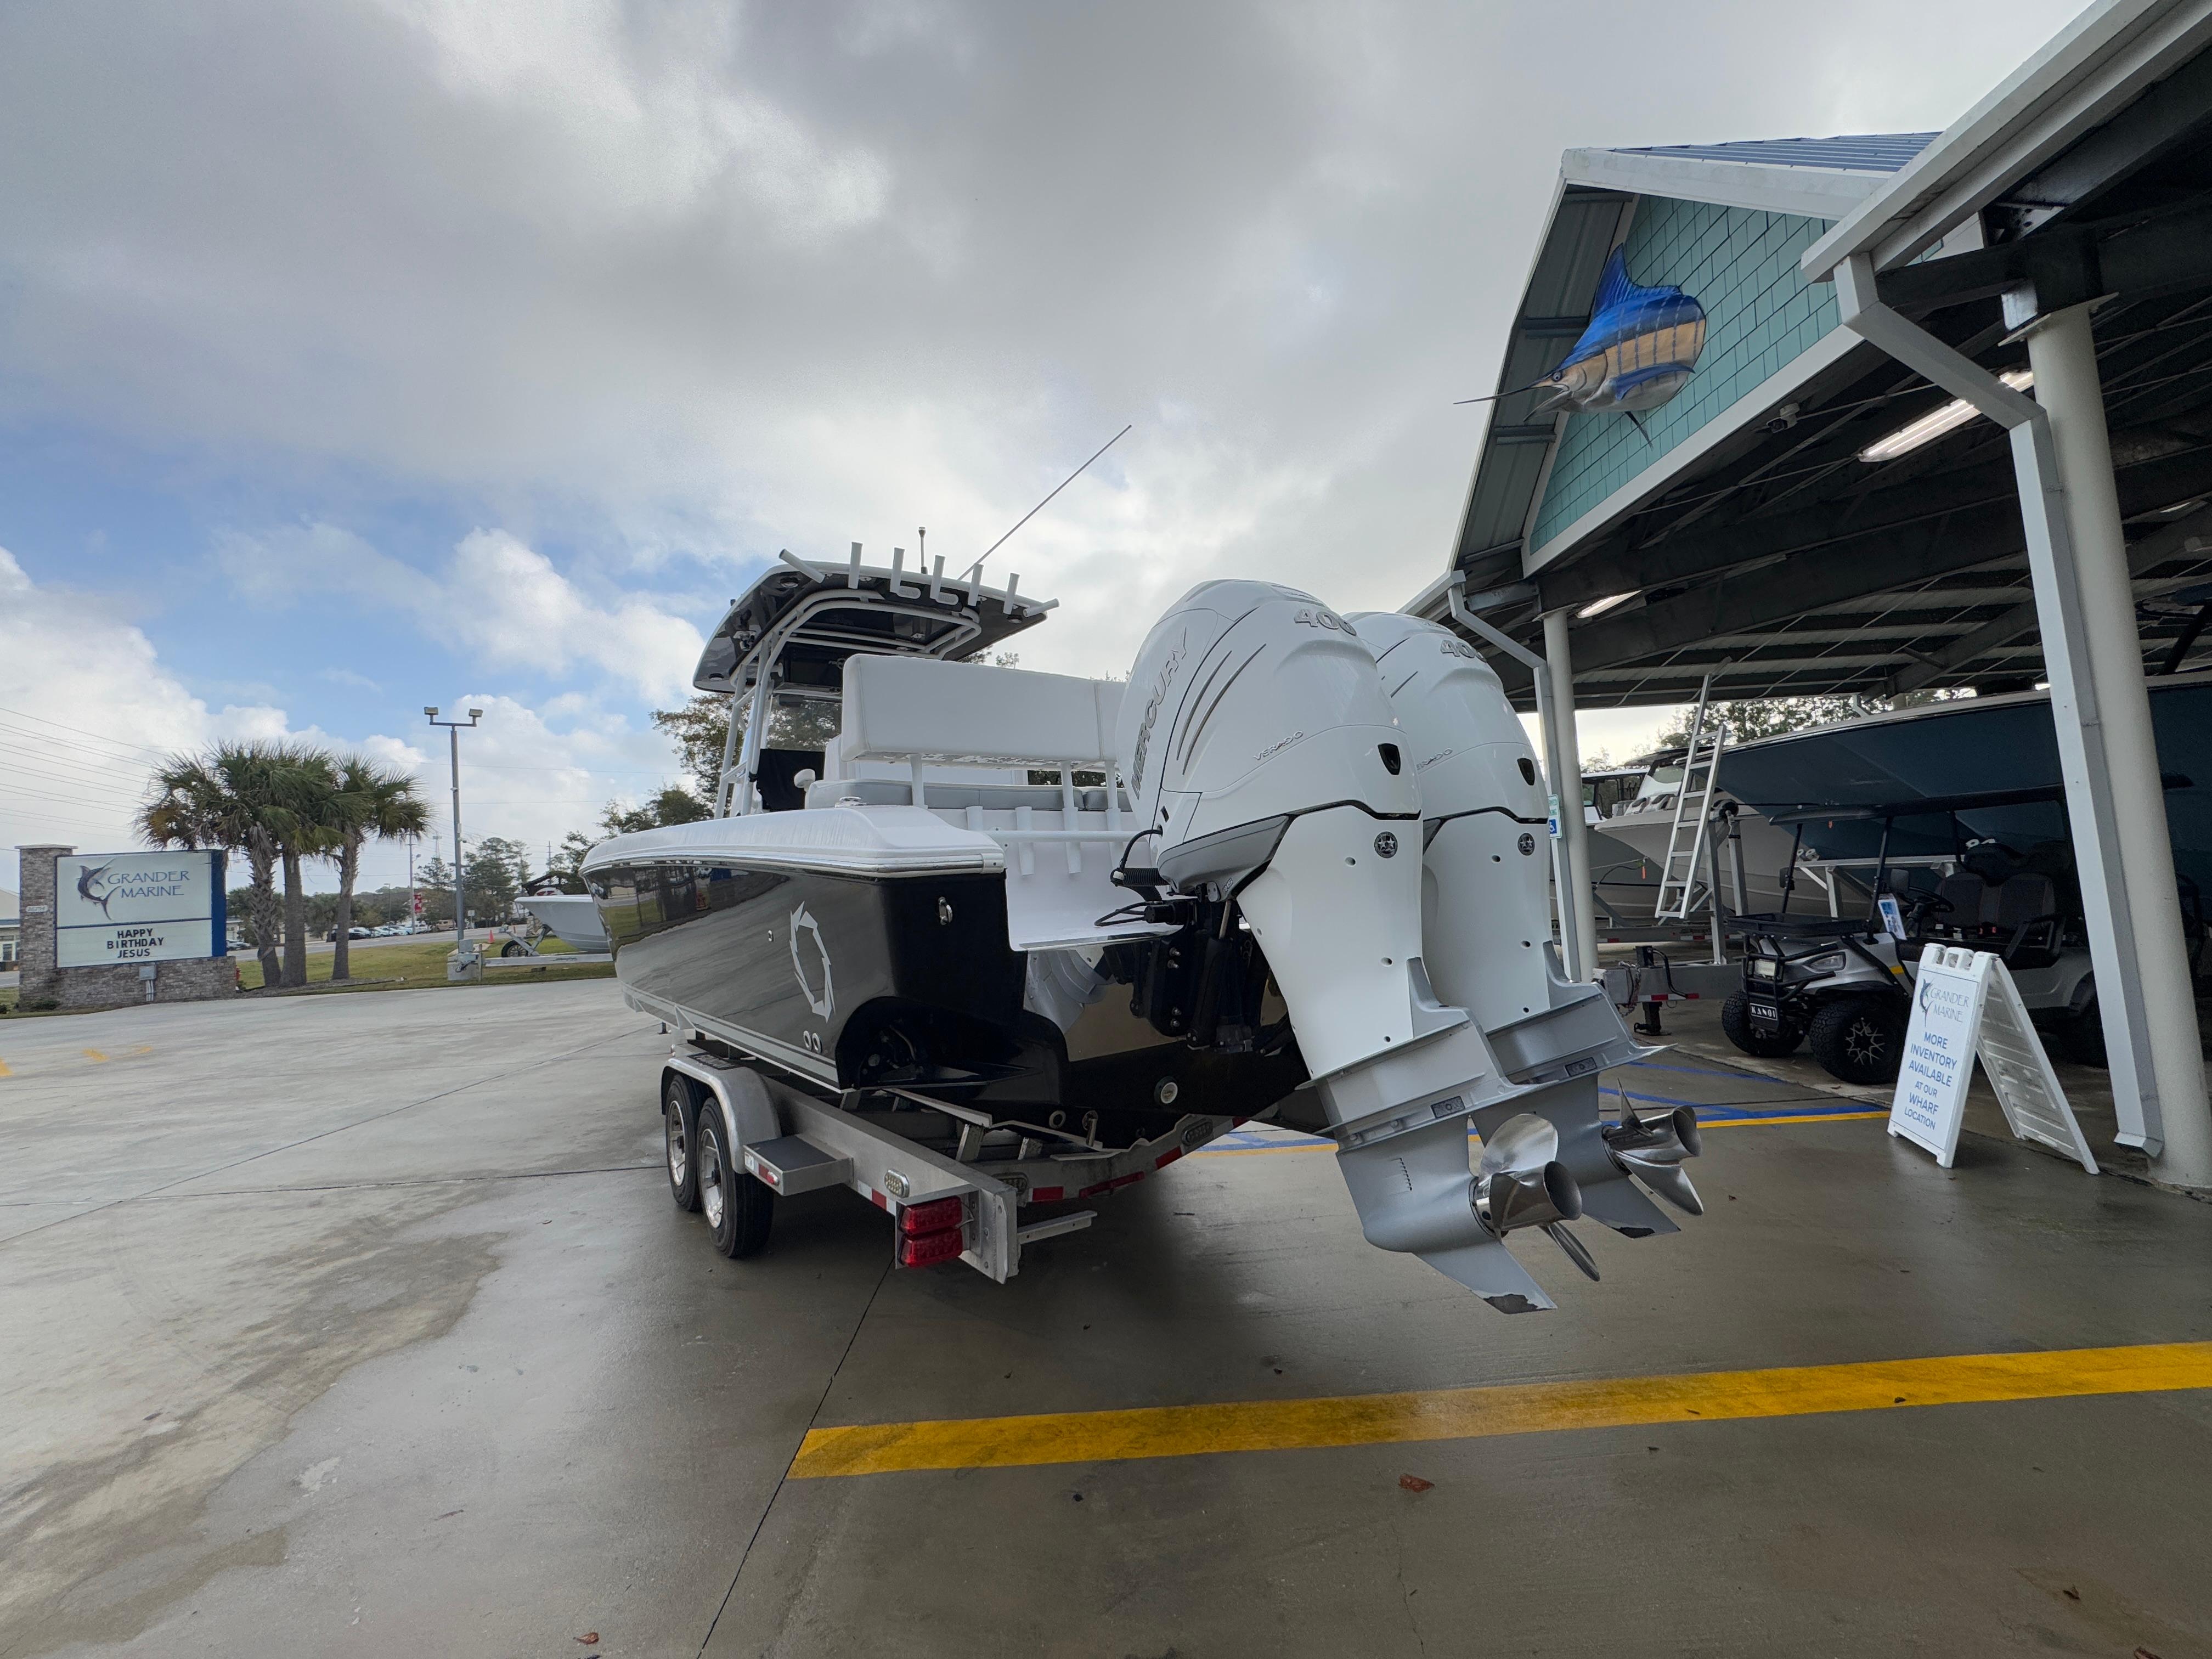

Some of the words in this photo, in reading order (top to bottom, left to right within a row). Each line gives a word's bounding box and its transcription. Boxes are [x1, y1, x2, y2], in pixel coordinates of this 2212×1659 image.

[1294, 608, 1357, 636] 400
[1131, 627, 1187, 800] MERCURY
[1251, 730, 1304, 760] VERADO
[1415, 748, 1453, 771] ERADO
[108, 871, 190, 884] GRANDER
[121, 885, 185, 898] MARINE
[107, 938, 164, 949] BIRTHDAY
[117, 928, 153, 939] HAPPY
[117, 949, 150, 958] JESUS
[1930, 987, 1970, 1008] GRANDER
[1933, 1003, 1963, 1023] MARINE
[1923, 1031, 1948, 1050] MORE
[1910, 1043, 1957, 1070] INVENTORY
[1909, 1059, 1952, 1087] AVAILABLE
[1915, 1081, 1923, 1090] AT
[1923, 1085, 1938, 1098] OUR
[1909, 1092, 1939, 1115] WHARF
[1904, 1106, 1936, 1130] LOCATION
